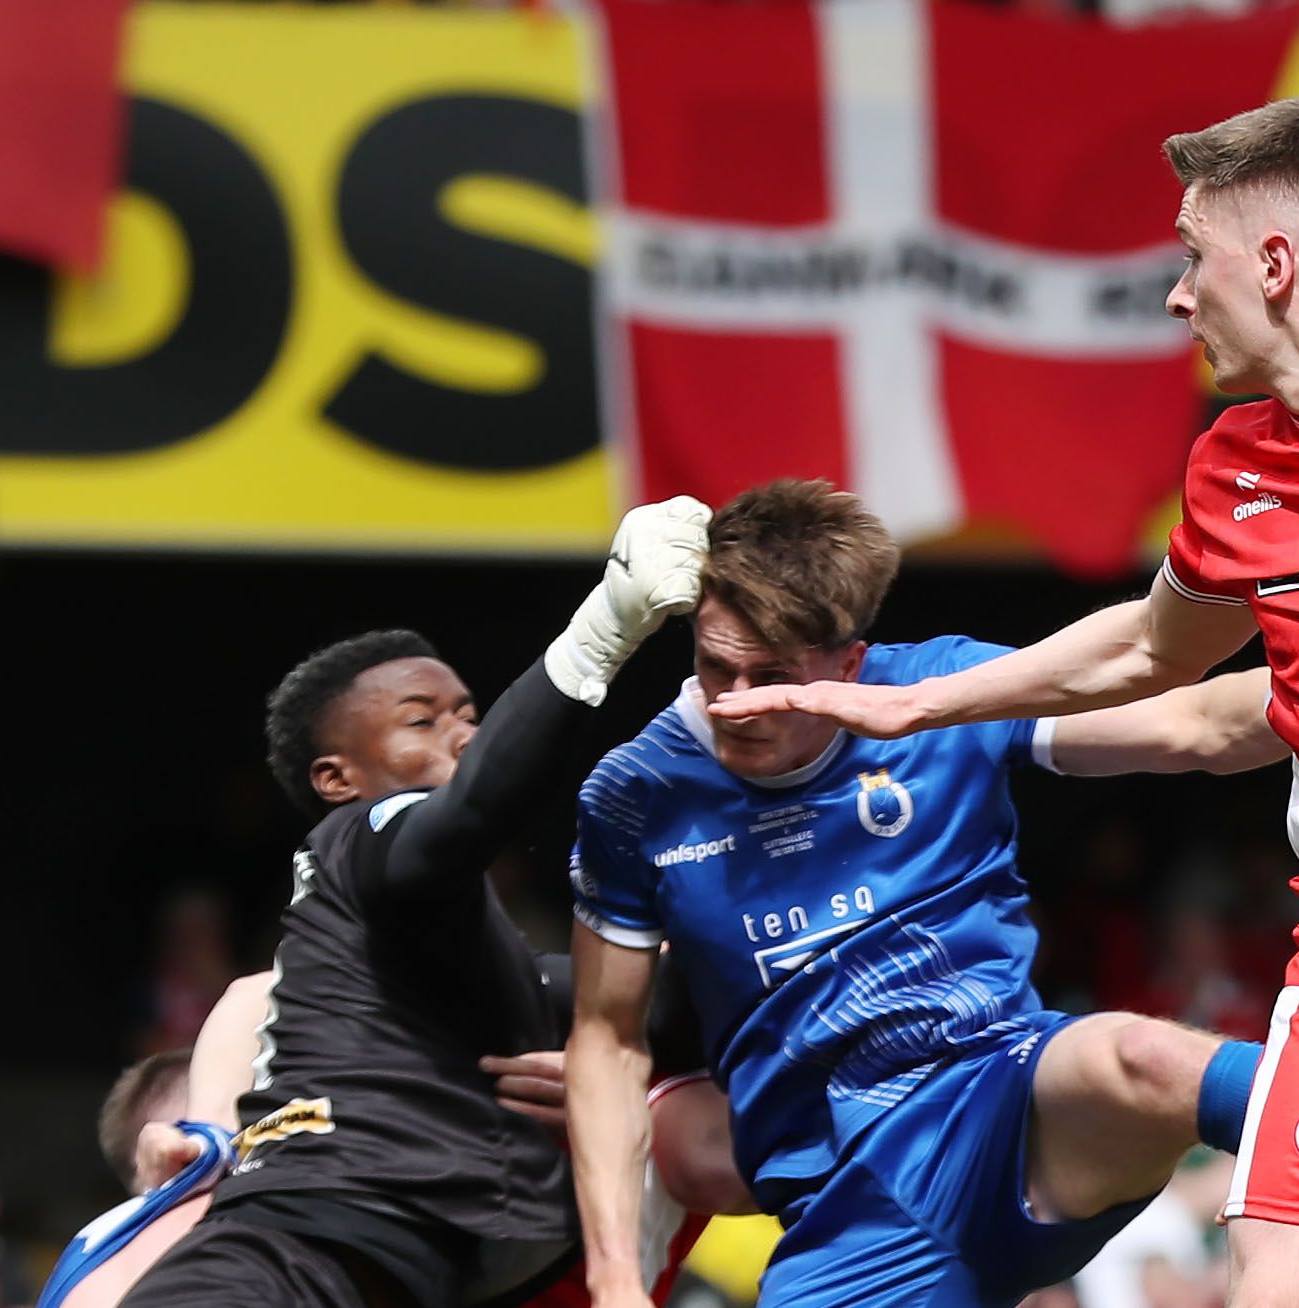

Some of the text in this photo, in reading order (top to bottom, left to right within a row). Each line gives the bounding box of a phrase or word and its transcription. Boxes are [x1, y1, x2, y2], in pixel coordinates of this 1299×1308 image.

[654, 834, 736, 868] uhlsport
[742, 886, 875, 942] ten sq
